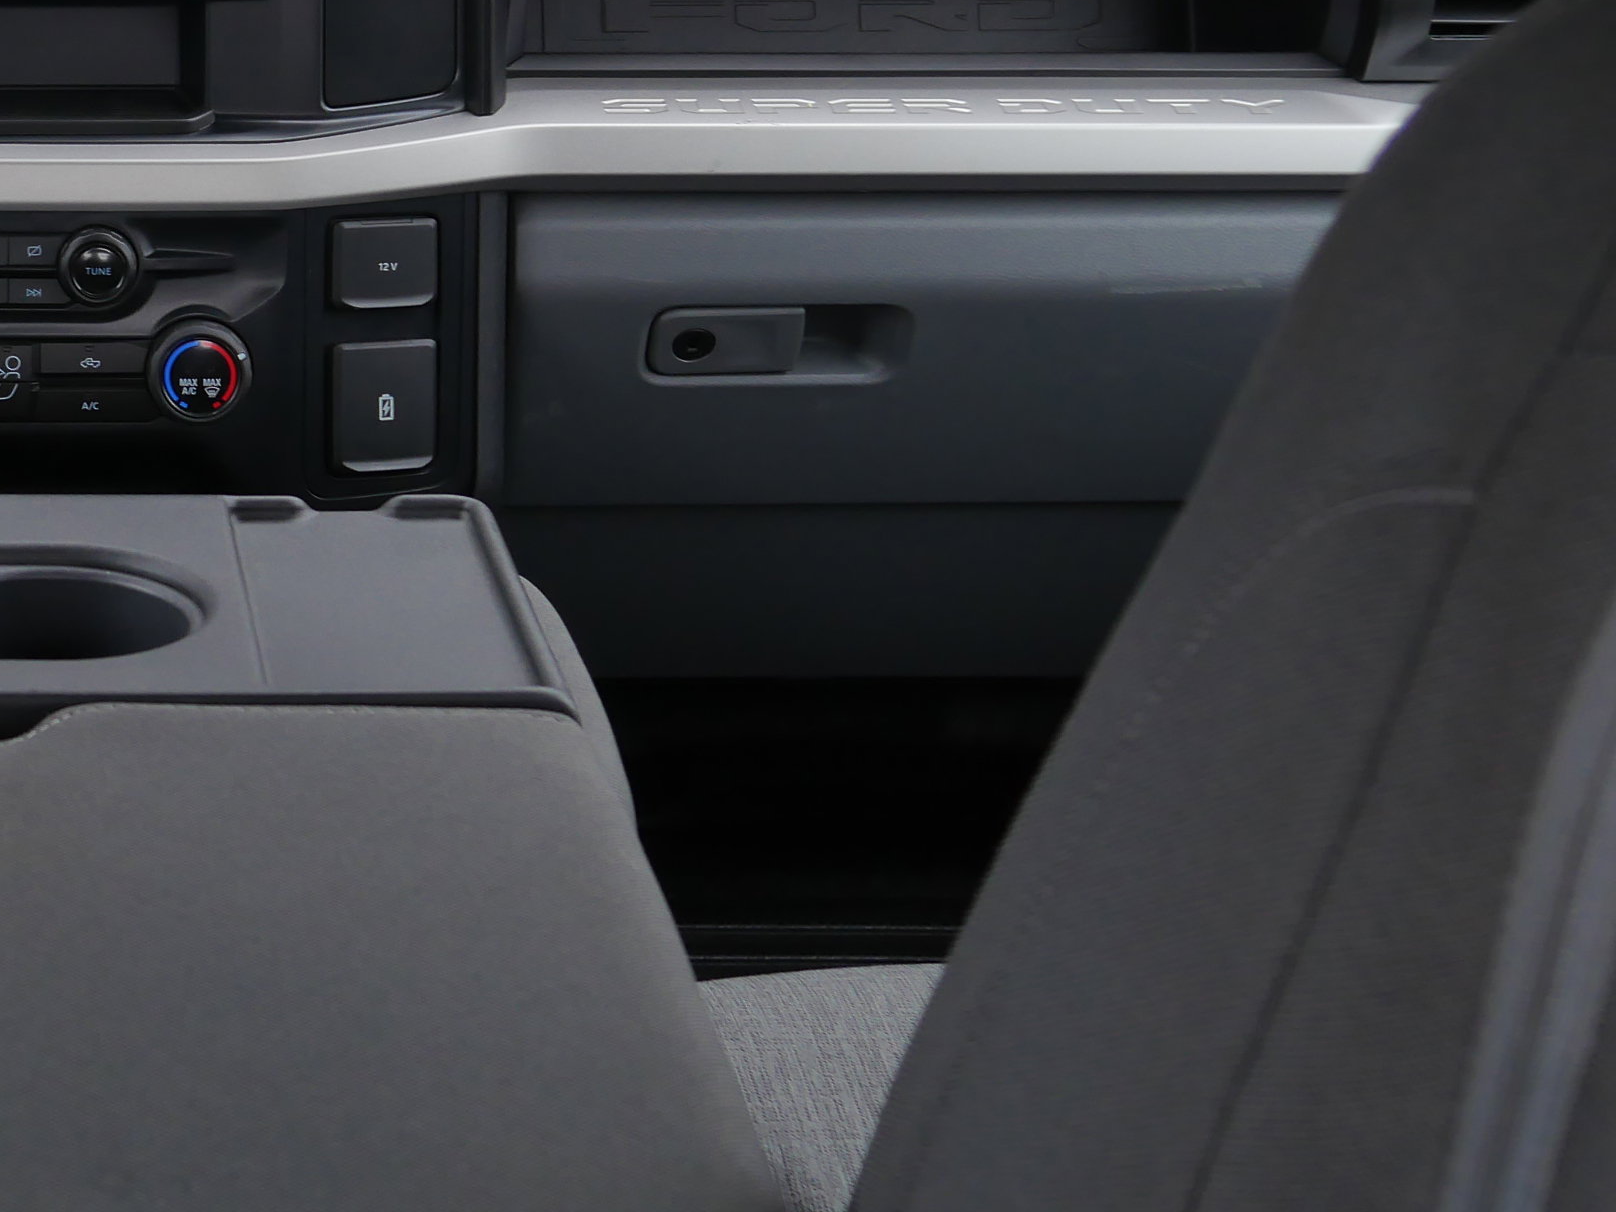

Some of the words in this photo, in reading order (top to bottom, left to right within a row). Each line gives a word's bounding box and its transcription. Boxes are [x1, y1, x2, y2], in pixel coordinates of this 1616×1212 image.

[600, 97, 974, 115] SUPER
[995, 97, 1285, 115] DUTY
[85, 266, 112, 277] TUNE
[179, 378, 198, 387] MAX
[202, 378, 222, 387] MAX
[181, 387, 197, 396] A/C
[81, 400, 100, 412] A/C
